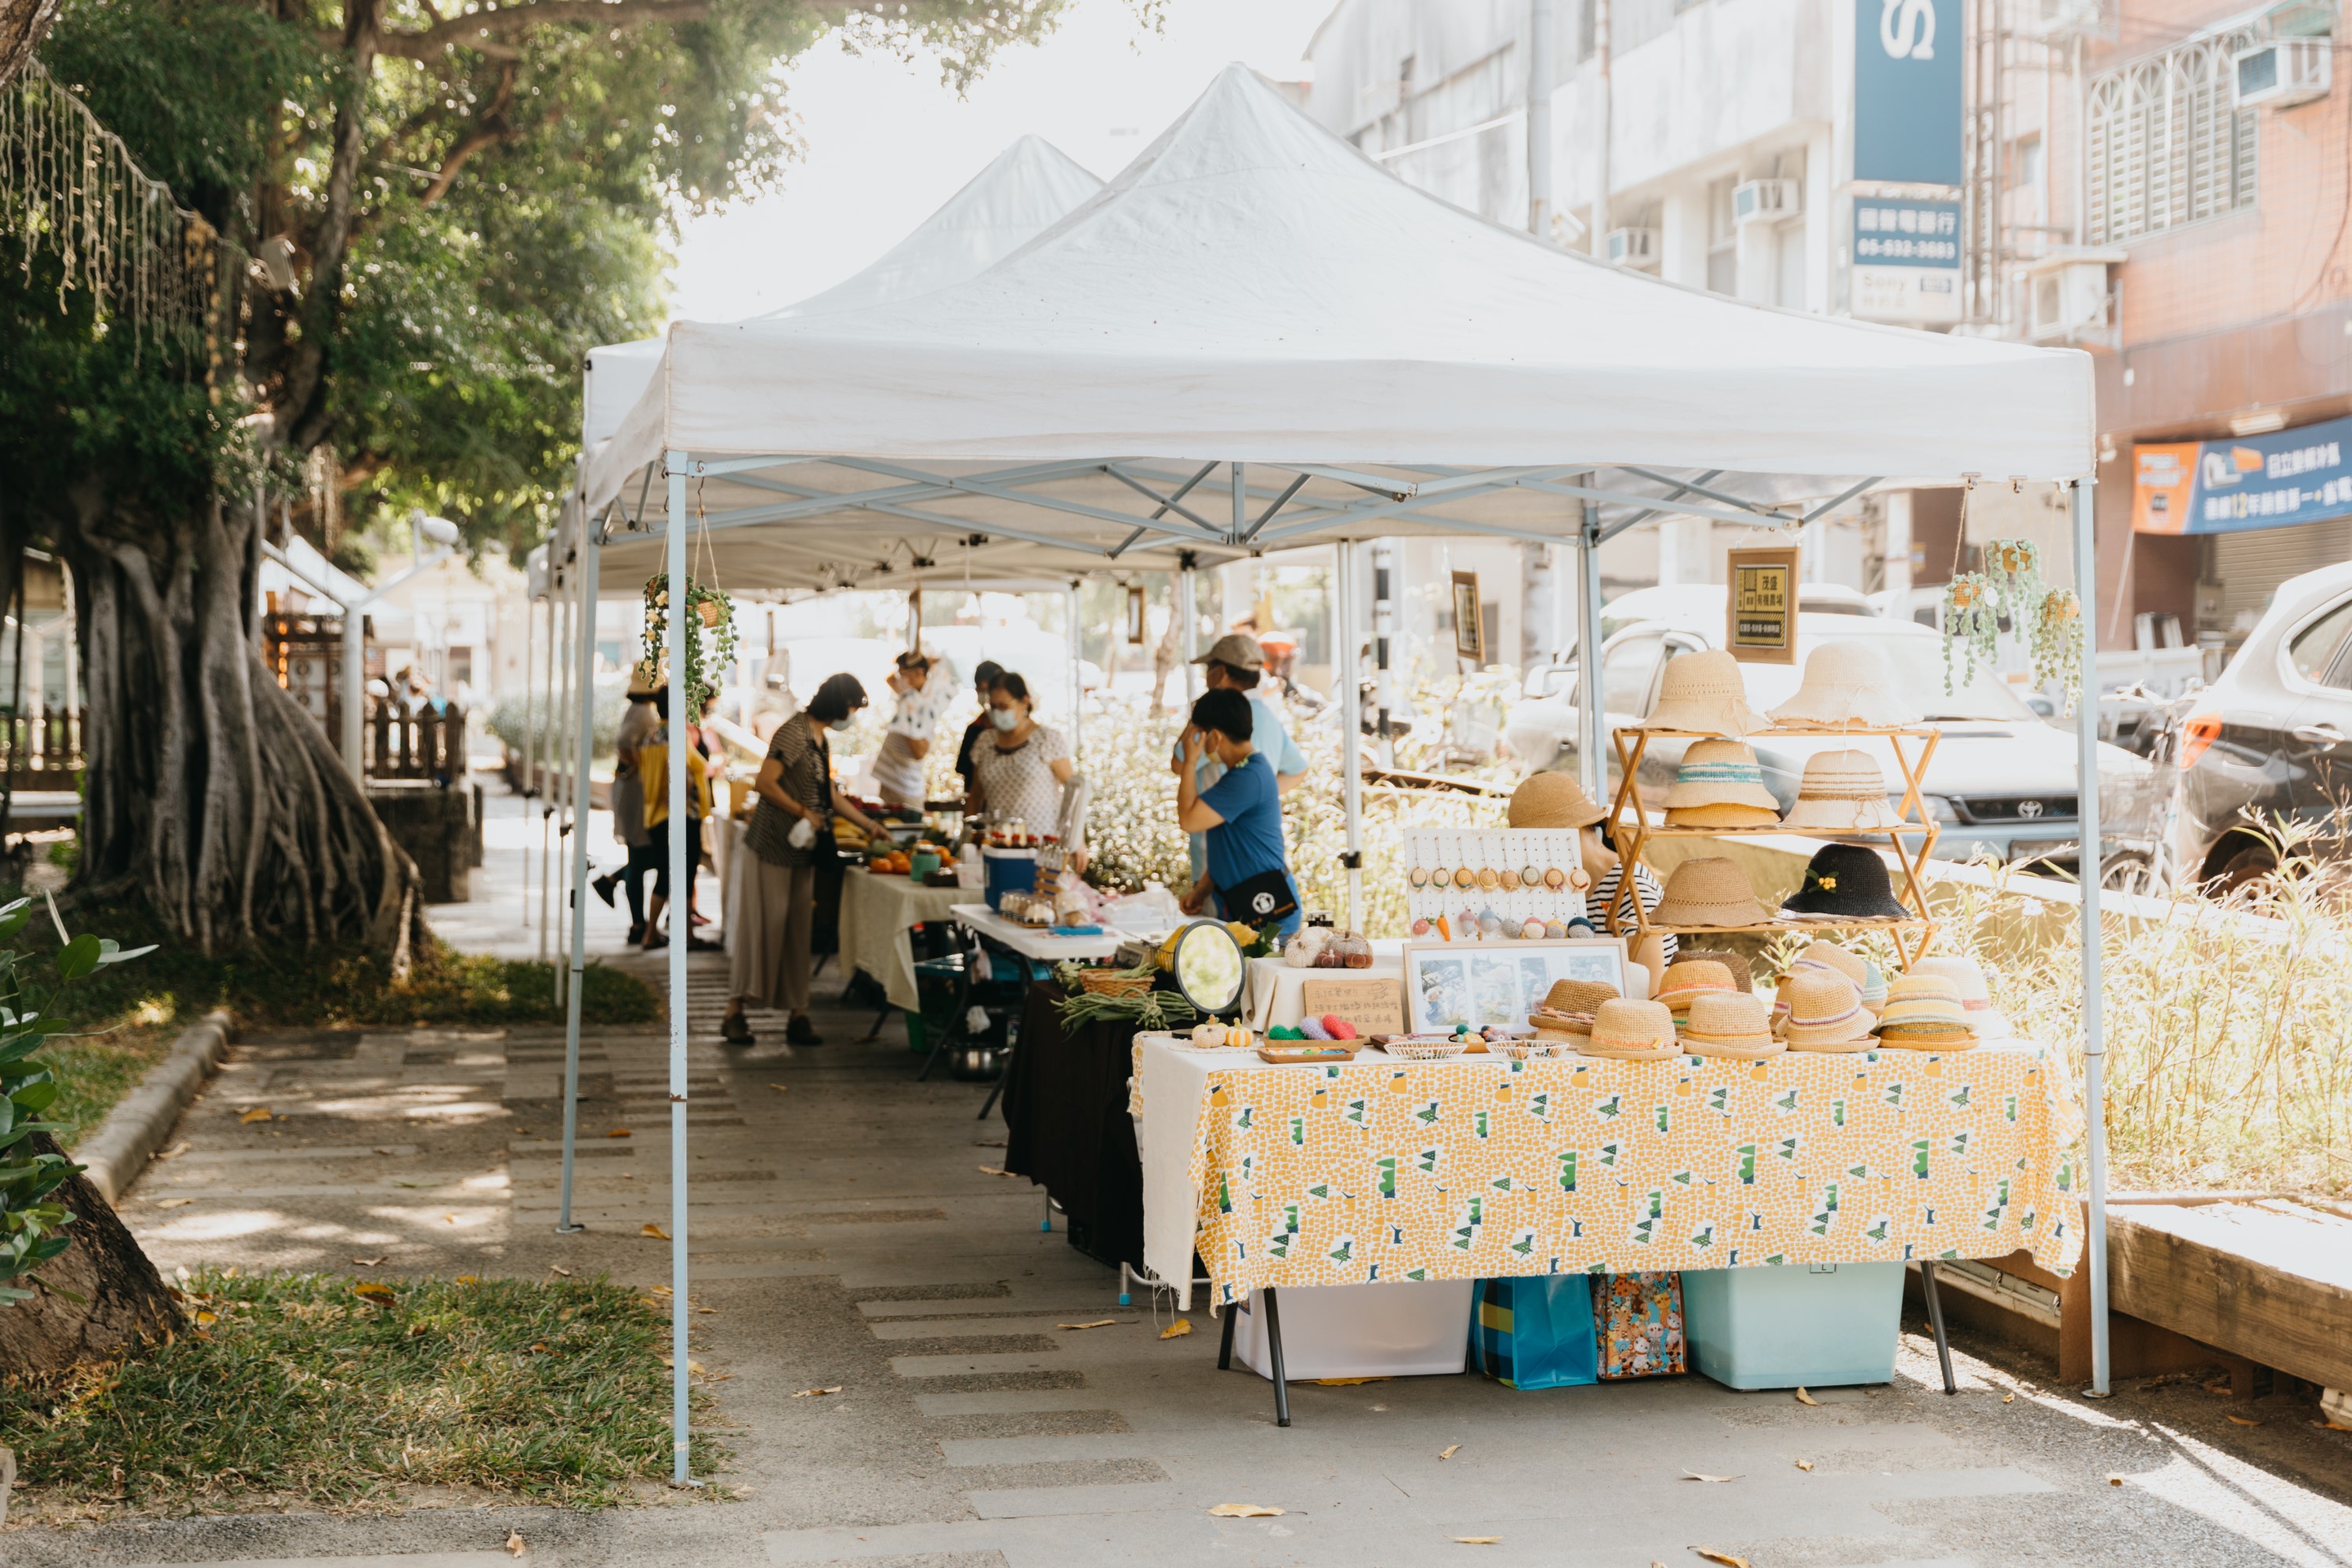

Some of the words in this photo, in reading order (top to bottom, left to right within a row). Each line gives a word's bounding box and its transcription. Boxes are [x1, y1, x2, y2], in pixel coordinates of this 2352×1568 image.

[1762, 576, 1777, 590] 茂盛
[1757, 594, 1783, 606] 有機農場
